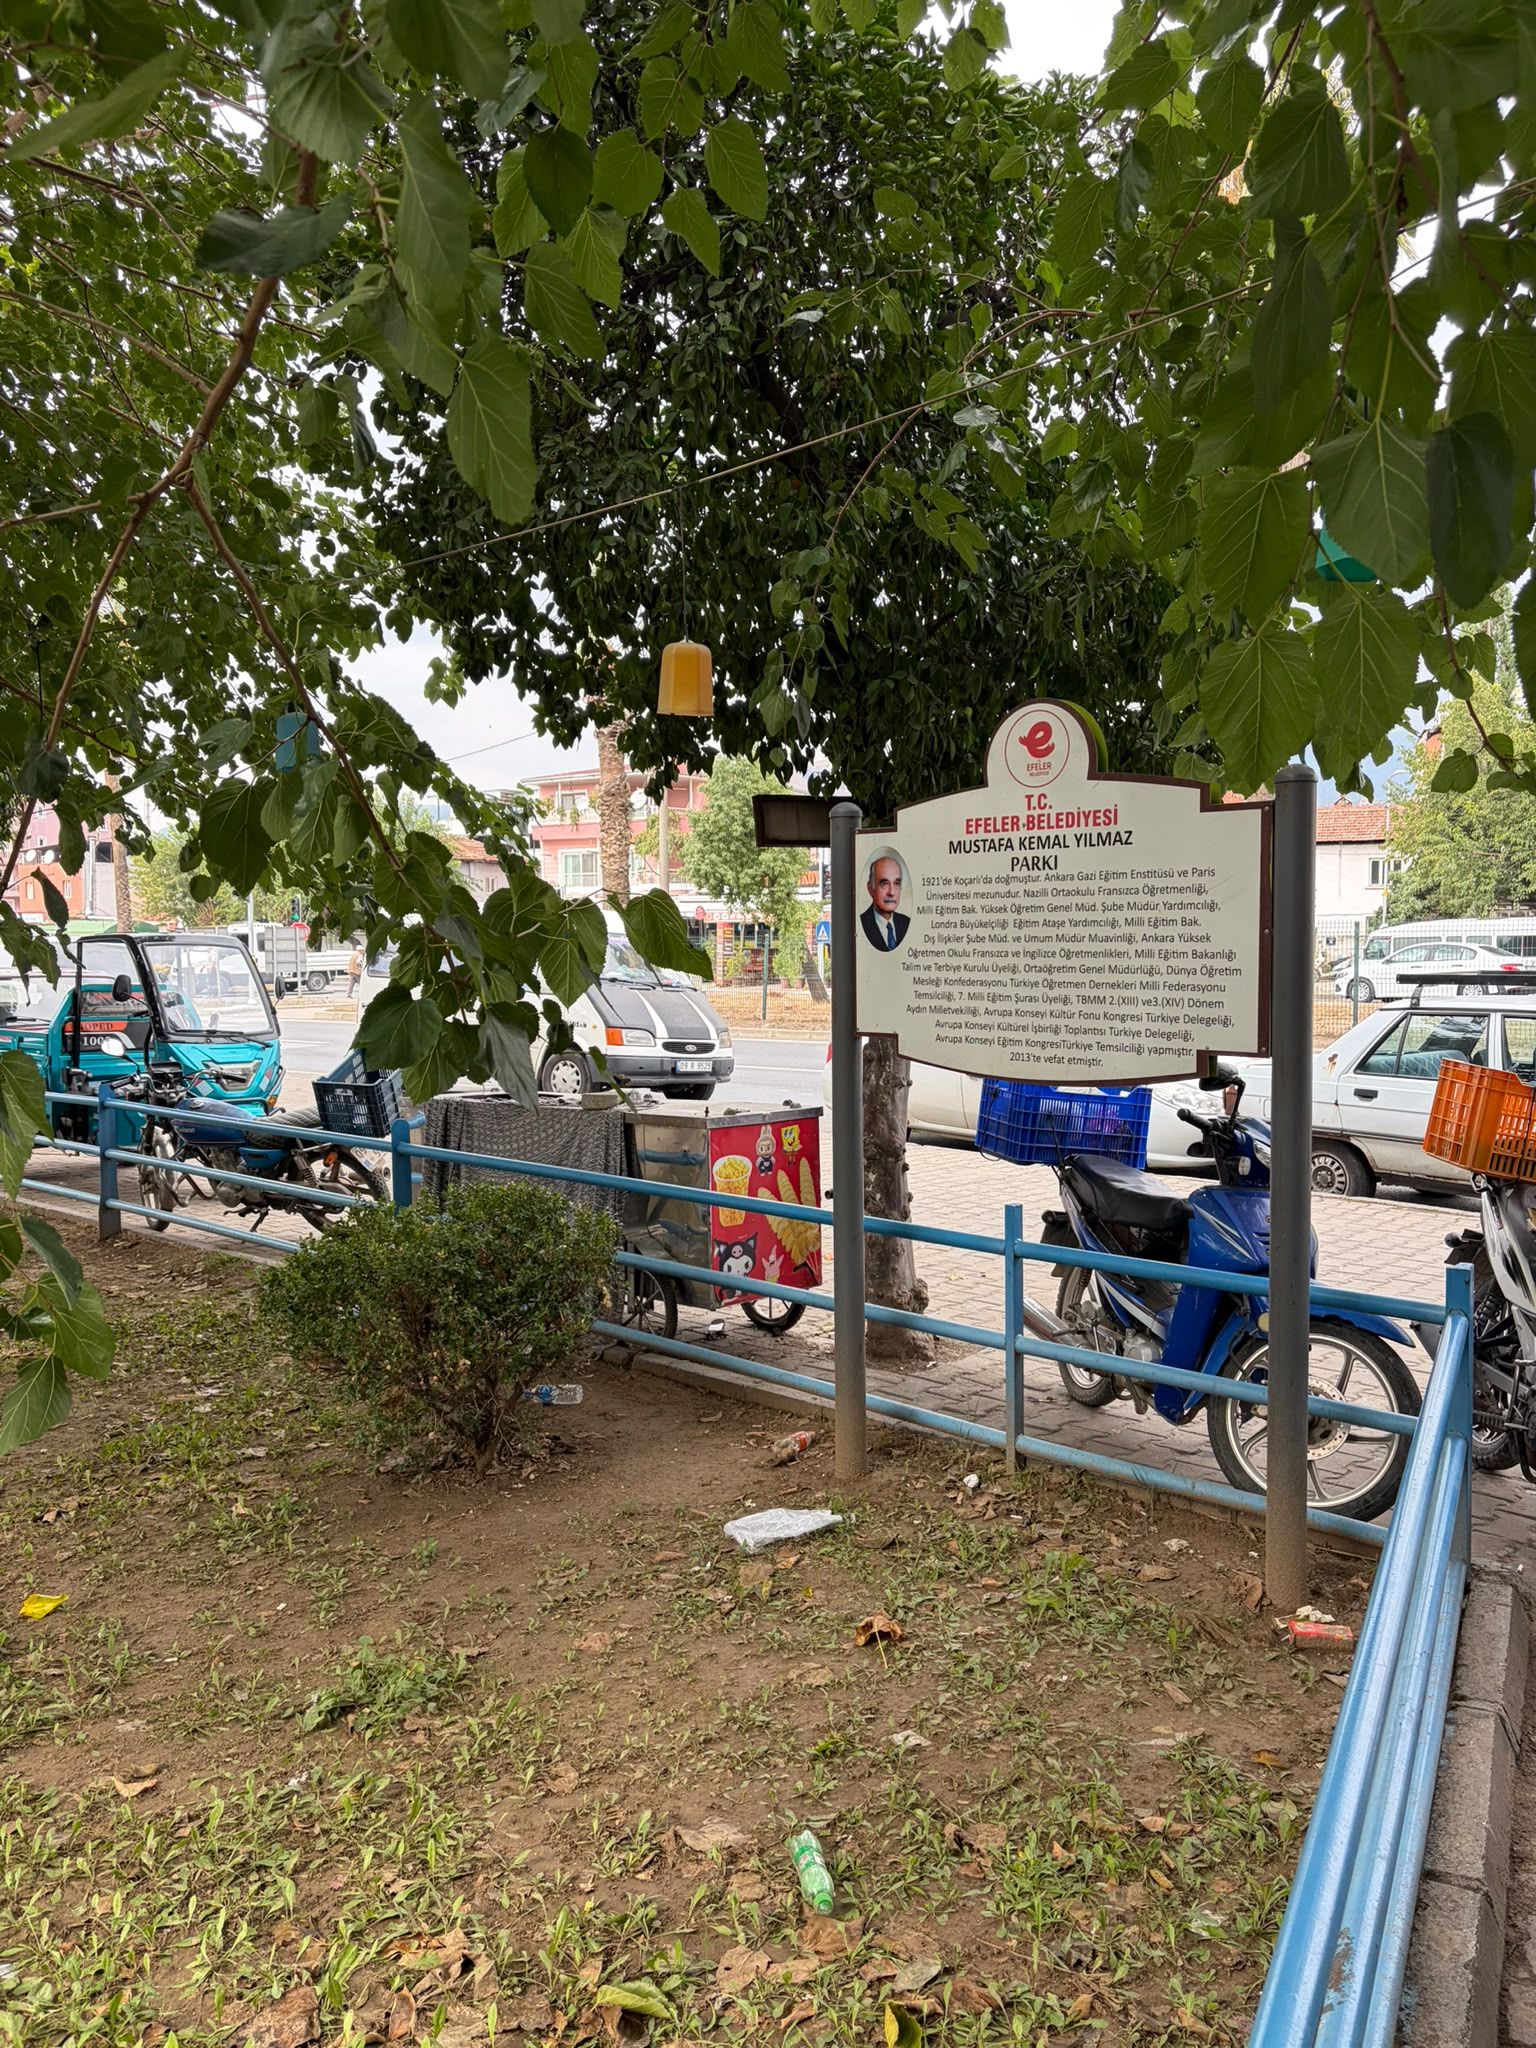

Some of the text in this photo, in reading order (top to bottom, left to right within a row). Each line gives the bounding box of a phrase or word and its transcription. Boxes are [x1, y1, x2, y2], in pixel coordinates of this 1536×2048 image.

[1027, 762, 1052, 772] EFELER
[1025, 793, 1052, 811] T.C.
[965, 804, 1118, 835] EFELER BELEDİYESİ
[949, 830, 1133, 855] MUSTAFA KEMAL YILMAZ
[1011, 855, 1058, 872] PARKI
[922, 867, 1215, 887] 1921'de Koçarlı'da doğmuştur. Ankara Gazi Eğitim Enstitüsü ve Paris
[926, 883, 1208, 900] Üniversitesi mezunudur. Nazilli Ortaokulu Fransızca Öğretmenliği,
[917, 900, 1221, 916] Milli Eğitim Bak. Yüksek Öğretim Genel Müd. Şube Müdür Yardımcılığı,
[931, 917, 1201, 930] Londra Büyükelçiliği Eğitim Ataşe Yardımcılığı, Milli Eğitim Bak.
[924, 934, 935, 944] Dış
[937, 934, 964, 944] İlişkiler
[967, 934, 986, 944] Şube
[988, 933, 1010, 942] Müd.
[1024, 934, 1052, 942] Umum
[1056, 933, 1085, 942] Müdür
[1088, 933, 1138, 945] Muavinliği,
[1141, 934, 1174, 942] Ankara
[1178, 933, 1212, 942] Yüksek
[908, 948, 945, 959] Öğretmen
[948, 949, 970, 958] Okulu
[972, 949, 1009, 958] Fransızca
[1023, 948, 1056, 959] İngilizce
[1059, 948, 1132, 960] Öğretmenlikleri,
[1135, 949, 1155, 959] Milli
[1158, 949, 1188, 960] Eğitim
[1192, 949, 1236, 961] Bakanlığı
[902, 962, 921, 971] Talim
[934, 962, 961, 973] Terbiye
[964, 963, 989, 972] Kurulu
[992, 963, 1021, 974] Üyeliği,
[1024, 963, 1076, 974] Ortaöğretim
[1079, 964, 1105, 974] Genel
[1108, 964, 1163, 977] Müdürlüğü,
[1167, 966, 1197, 978] Dünya
[1200, 965, 1241, 978] Öğretim
[913, 977, 1225, 993] Mesleği Konfederasyonu Türkiye Öğretmen Dernekleri Milli Federasyonu
[914, 991, 956, 1001] Temsilciliği,
[958, 992, 965, 1000] 7.
[968, 992, 985, 1001] Milli
[987, 993, 1012, 1003] Eğitim
[1015, 993, 1039, 1005] Şurası
[1042, 994, 1073, 1005] Üyeliği,
[1076, 995, 1106, 1005] TBMM
[1109, 996, 1138, 1008] 2.(XIII)
[1188, 998, 1224, 1008] Dönem
[906, 1005, 927, 1015] Aydın
[984, 1007, 1012, 1017] Avrupa
[1015, 1008, 1047, 1019] Konseyi
[1050, 1008, 1076, 1019] Kültür
[1079, 1011, 1100, 1021] Fonu
[1103, 1012, 1142, 1023] Kongresi
[1145, 1013, 1180, 1025] Türkiye
[1183, 1014, 1234, 1028] Delegeliği,
[935, 1020, 1194, 1042] Avrupa Konseyi Kültürel İşbirliği Toplantısı Türkiye Delegeliği,
[935, 1034, 962, 1044] Avrupa
[965, 1035, 994, 1046] Konseyi
[998, 1036, 1022, 1048] Eğitim
[1096, 1042, 1144, 1055] Temsilciliği
[1148, 1046, 1194, 1058] yapmıştır.
[1010, 1052, 1103, 1068] 2013'te vefat etmiştir.
